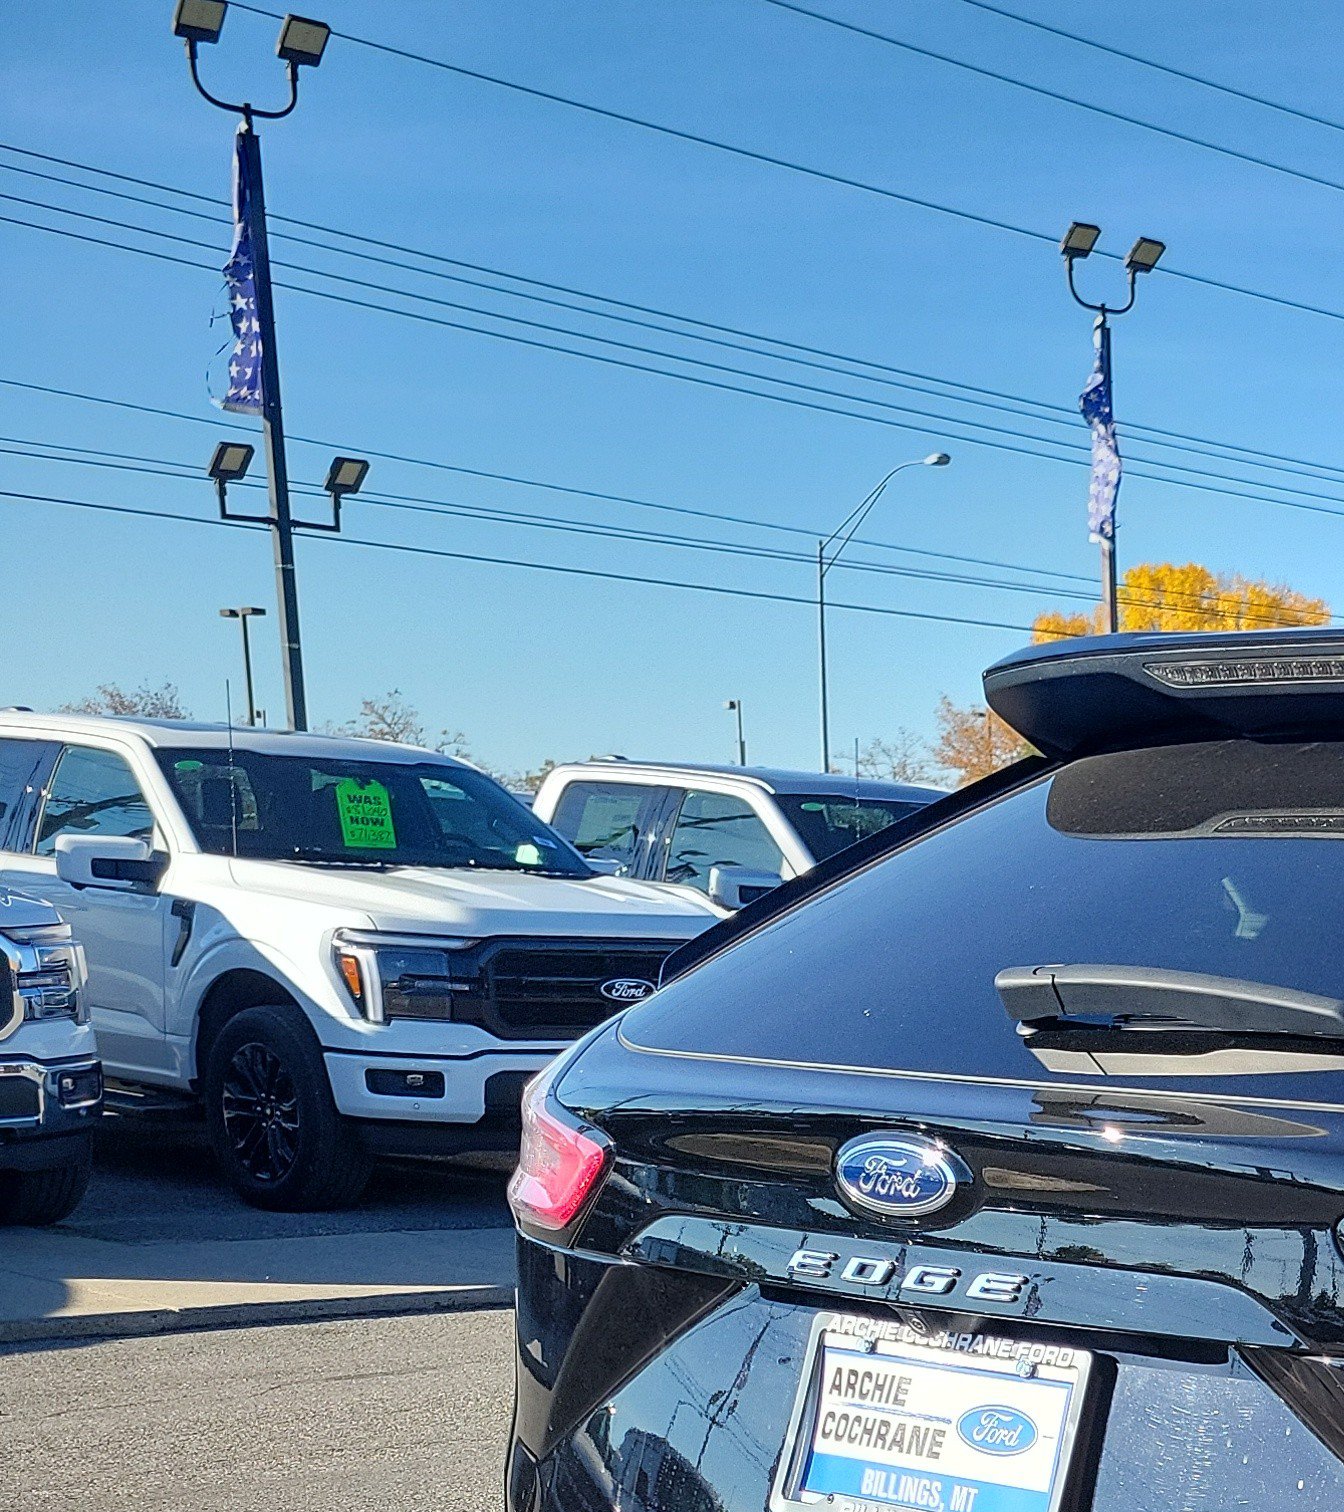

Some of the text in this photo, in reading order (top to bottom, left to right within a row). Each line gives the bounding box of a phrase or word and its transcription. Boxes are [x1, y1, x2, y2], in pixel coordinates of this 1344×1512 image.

[347, 794, 382, 805] WAS
[350, 816, 385, 826] NOW
[612, 981, 646, 997] Ford
[859, 1155, 922, 1199] Ford
[787, 1250, 1029, 1302] EDGE
[826, 1314, 898, 1340] ARCHIE
[1015, 1342, 1074, 1368] FORD
[829, 1367, 912, 1406] ARCHIE
[821, 1411, 946, 1459] COCHRANE
[972, 1411, 1021, 1447] Ford
[861, 1469, 944, 1512] BILLINGS,
